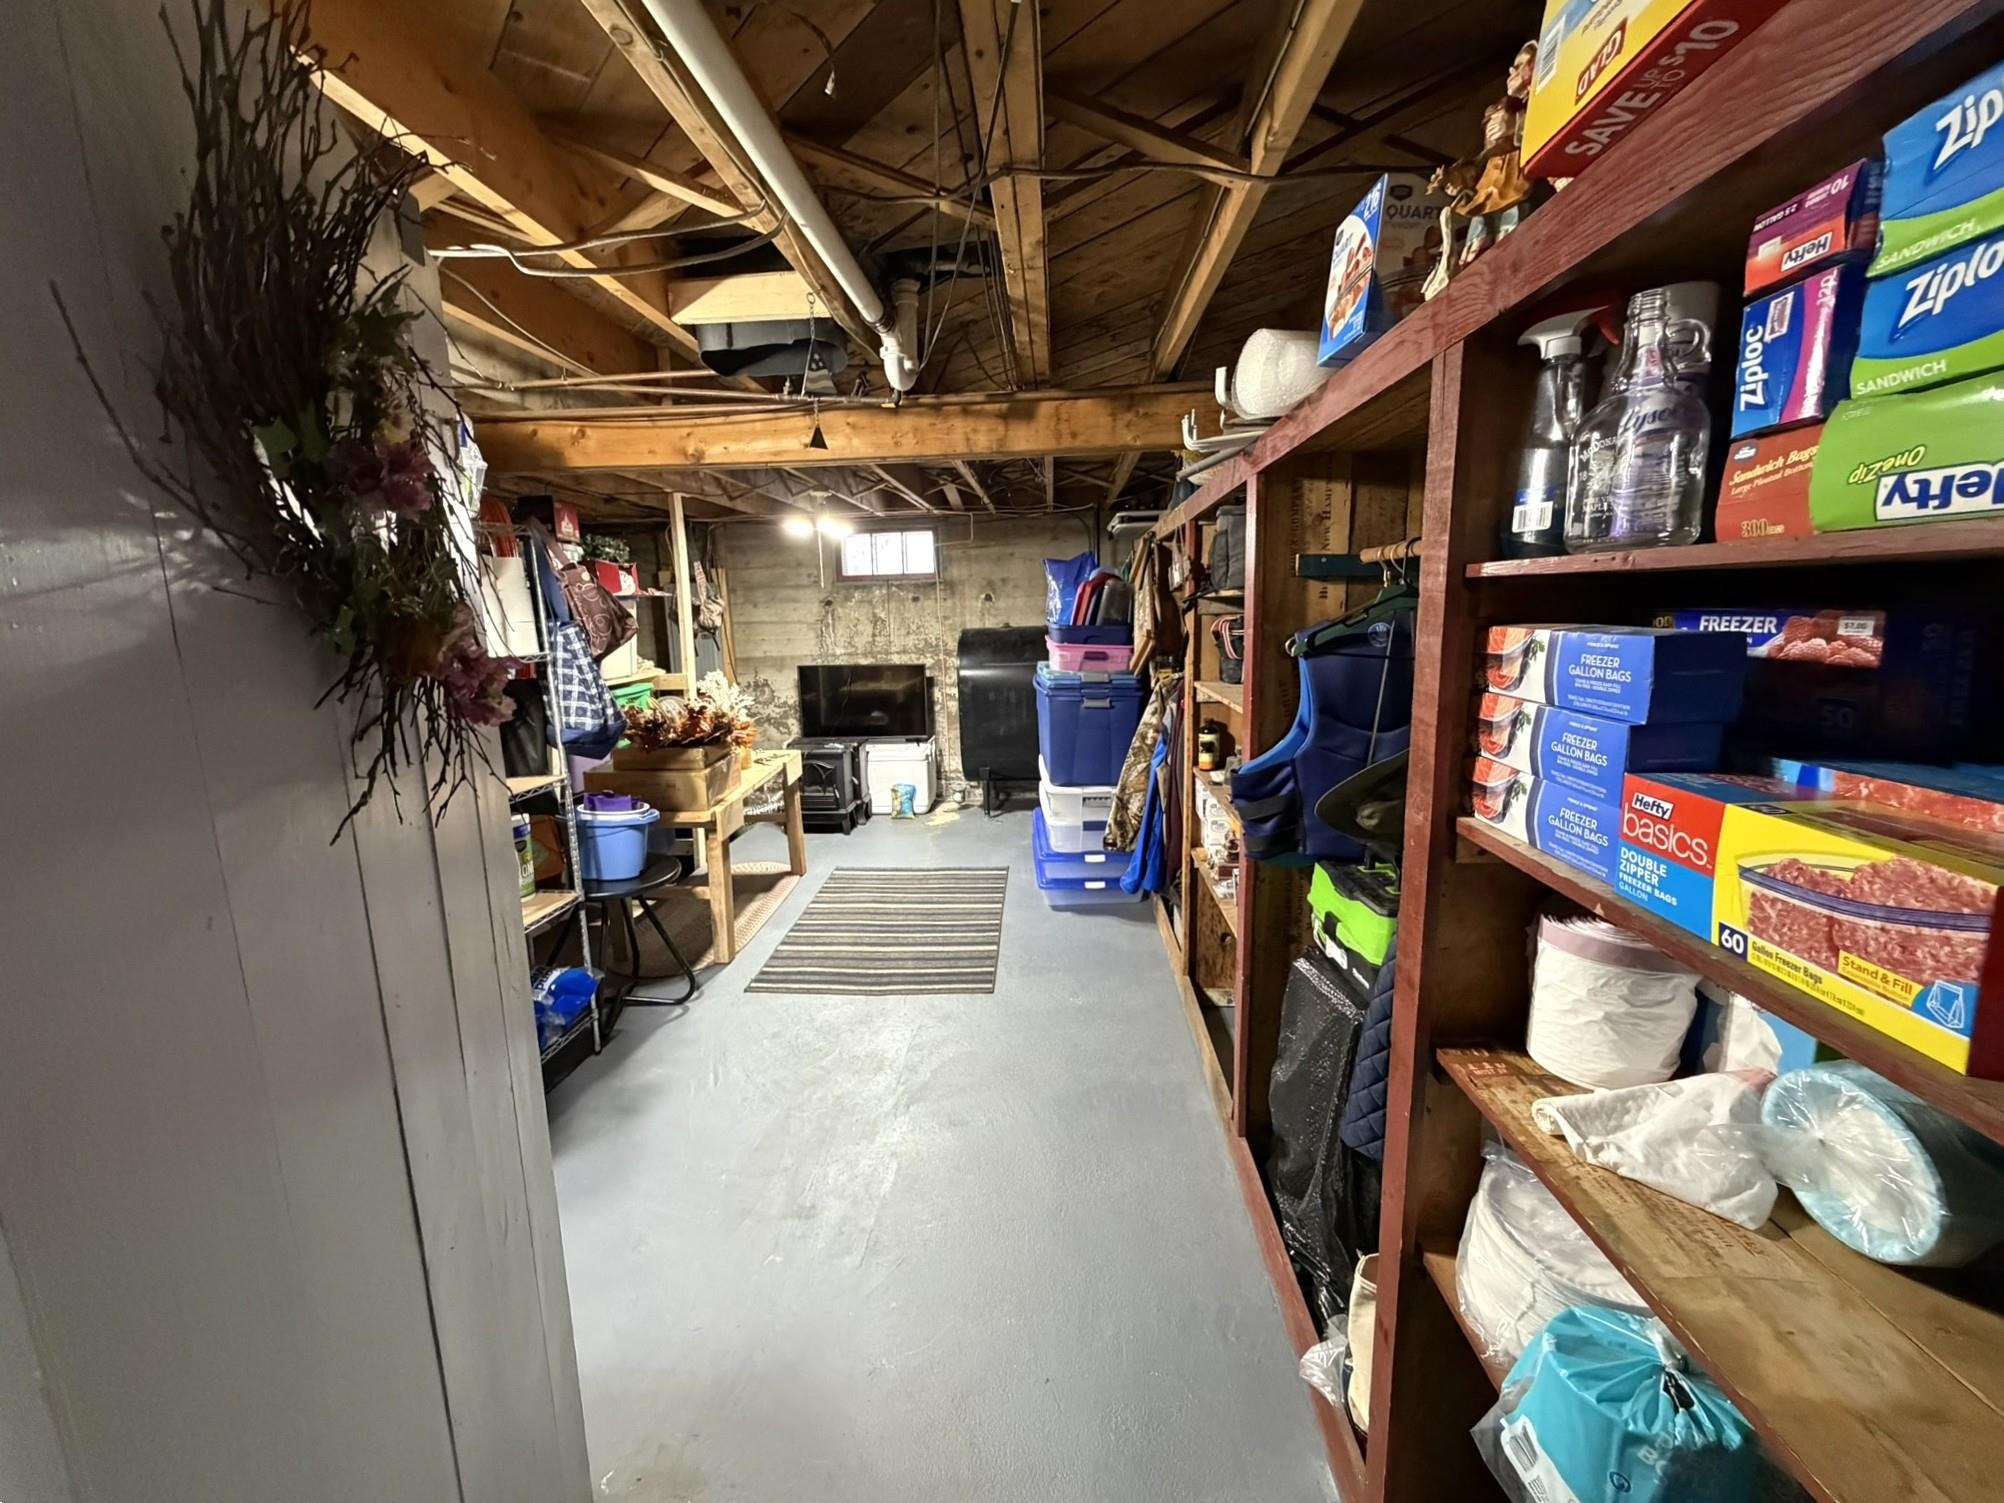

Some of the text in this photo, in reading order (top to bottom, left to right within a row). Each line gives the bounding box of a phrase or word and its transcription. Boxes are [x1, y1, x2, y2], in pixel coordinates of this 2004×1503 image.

[1659, 19, 1740, 67] $10
[1578, 30, 1622, 94] GLAD
[1652, 69, 1687, 90] TO
[1565, 91, 1661, 156] SAVE
[1784, 235, 1830, 265] Hefty
[1875, 219, 1975, 269] SANDWICH
[1740, 325, 1768, 411] Ziploc
[1857, 359, 1947, 395] SANDWICH
[1729, 445, 1820, 486] Sandwich Bags
[1848, 444, 1928, 485] OneZip
[1741, 519, 1768, 538] 300
[1700, 616, 1777, 634] FREEZER
[1568, 665, 1632, 682] GALLON BAGS
[1580, 654, 1620, 669] FREEZER
[1551, 741, 1582, 760] GALLON
[1583, 751, 1608, 767] BAGS
[1561, 732, 1598, 750] FREEZER
[1559, 807, 1598, 830] FREEZER
[1634, 795, 1669, 818] Hefty
[1548, 815, 1582, 836] GALLON
[1583, 829, 1609, 847] BAGS
[1623, 803, 1708, 865] basics
[1620, 860, 1659, 887] ZIPPER
[1621, 847, 1668, 877] DOUBLE
[1619, 872, 1678, 906] FREEZER BAGS
[1619, 881, 1649, 901] GALLON
[1721, 929, 1744, 954] 60
[1775, 952, 1803, 974] Freezer
[1803, 965, 1823, 985] Bags
[1842, 955, 1878, 980] Stand
[1879, 972, 1891, 986] &
[1892, 979, 1914, 995] Fill
